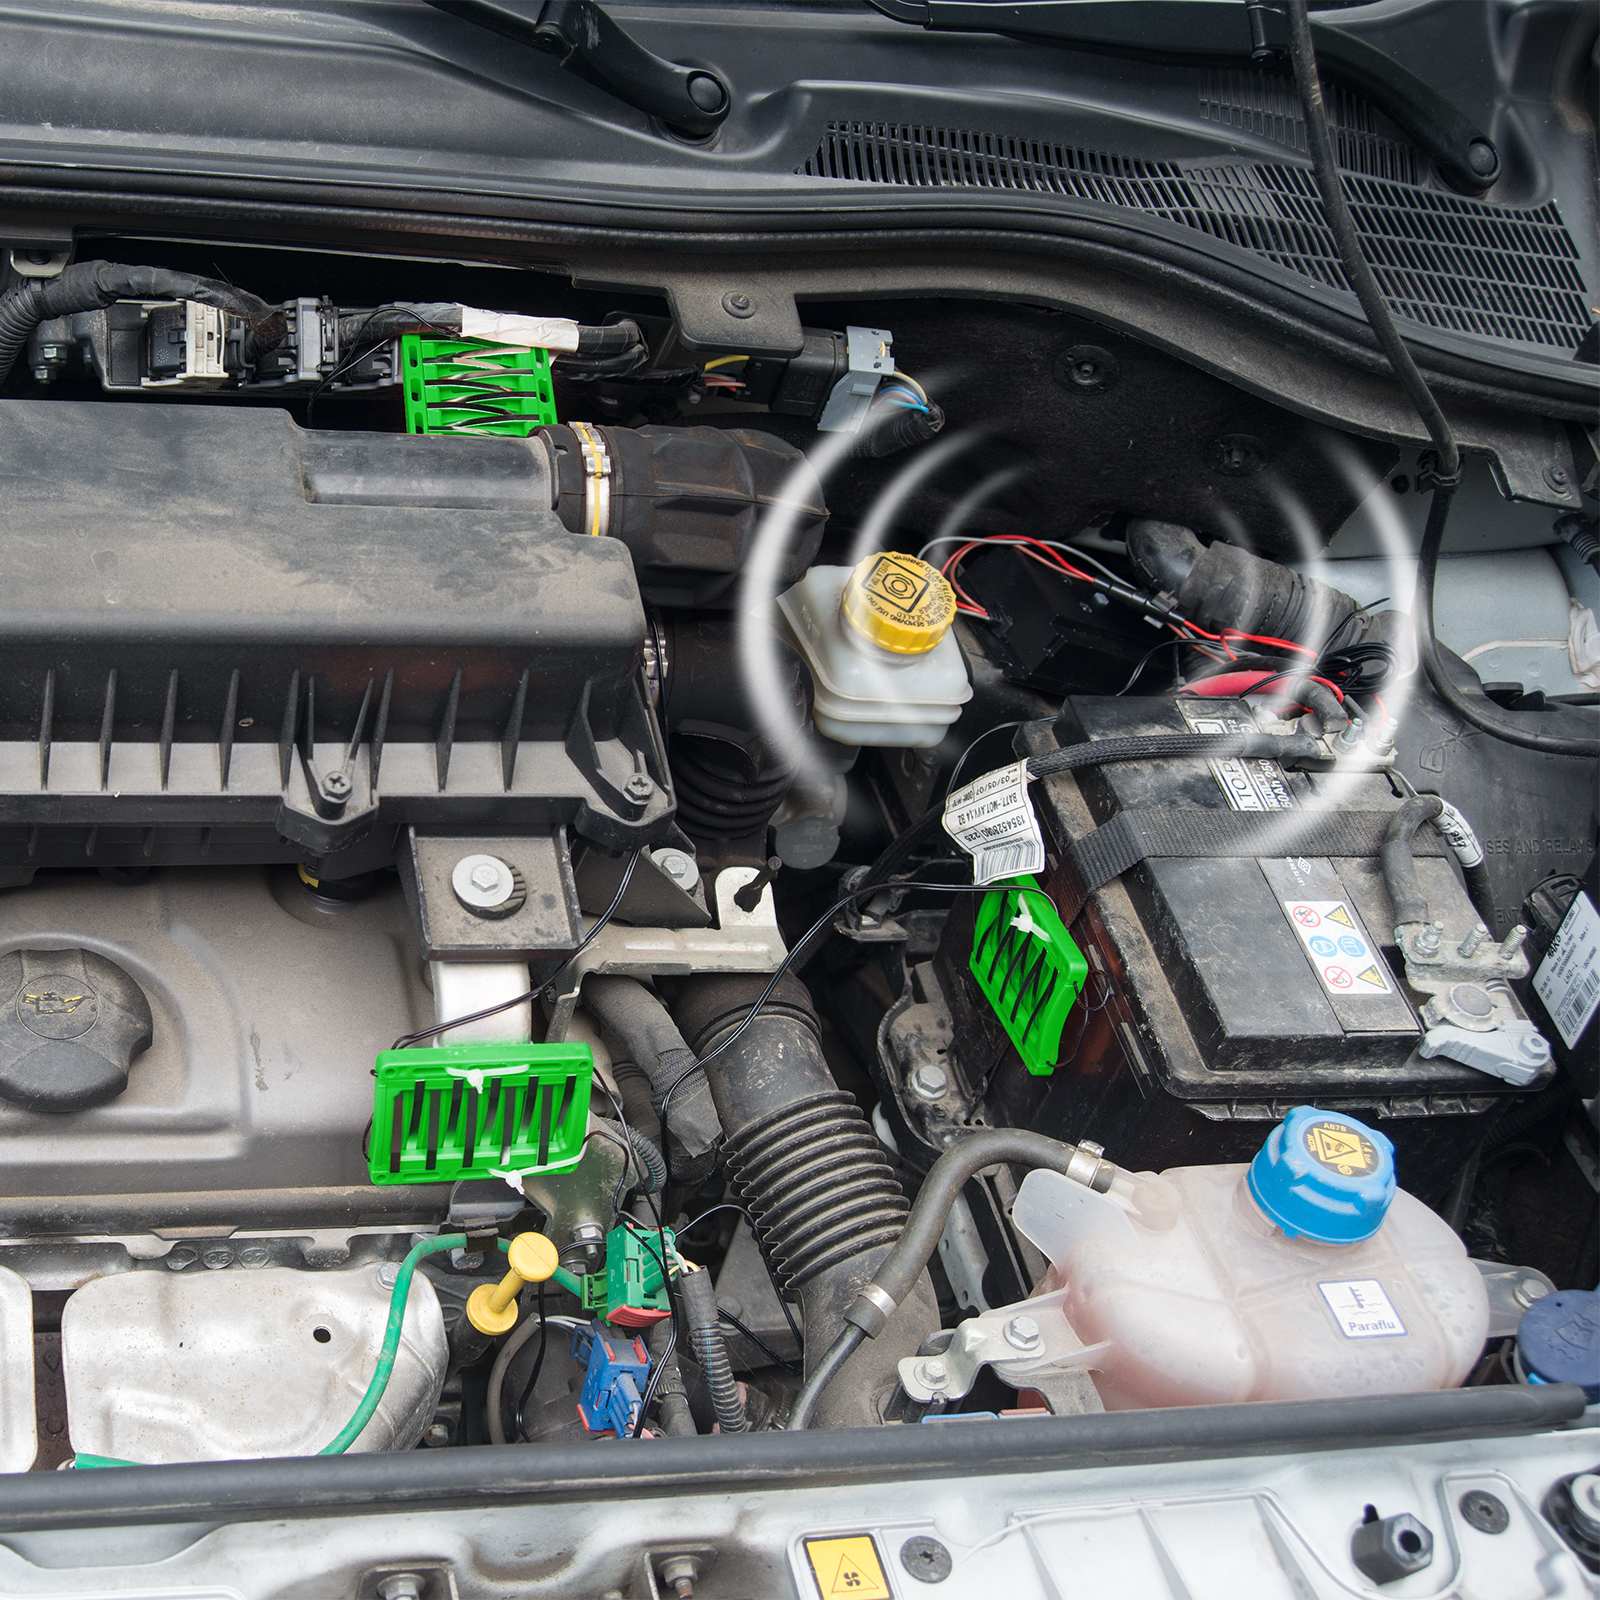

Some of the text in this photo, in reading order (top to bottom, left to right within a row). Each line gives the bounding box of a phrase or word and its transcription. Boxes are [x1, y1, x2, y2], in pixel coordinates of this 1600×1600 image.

[924, 572, 935, 583] DOT
[865, 555, 952, 627] WARNING! CLEAN FILLER CAP BEFORE REMOVING USE ONLY
[918, 591, 936, 614] CONTAINER
[931, 602, 943, 615] FROM
[897, 611, 925, 621] SEALED
[976, 775, 1010, 795] 03/05/07
[1270, 780, 1292, 807] 50Ah
[964, 833, 980, 842] 225
[1515, 838, 1540, 854] AND
[1545, 838, 1594, 854] RELAYS
[1348, 1320, 1395, 1331] Paraflu
